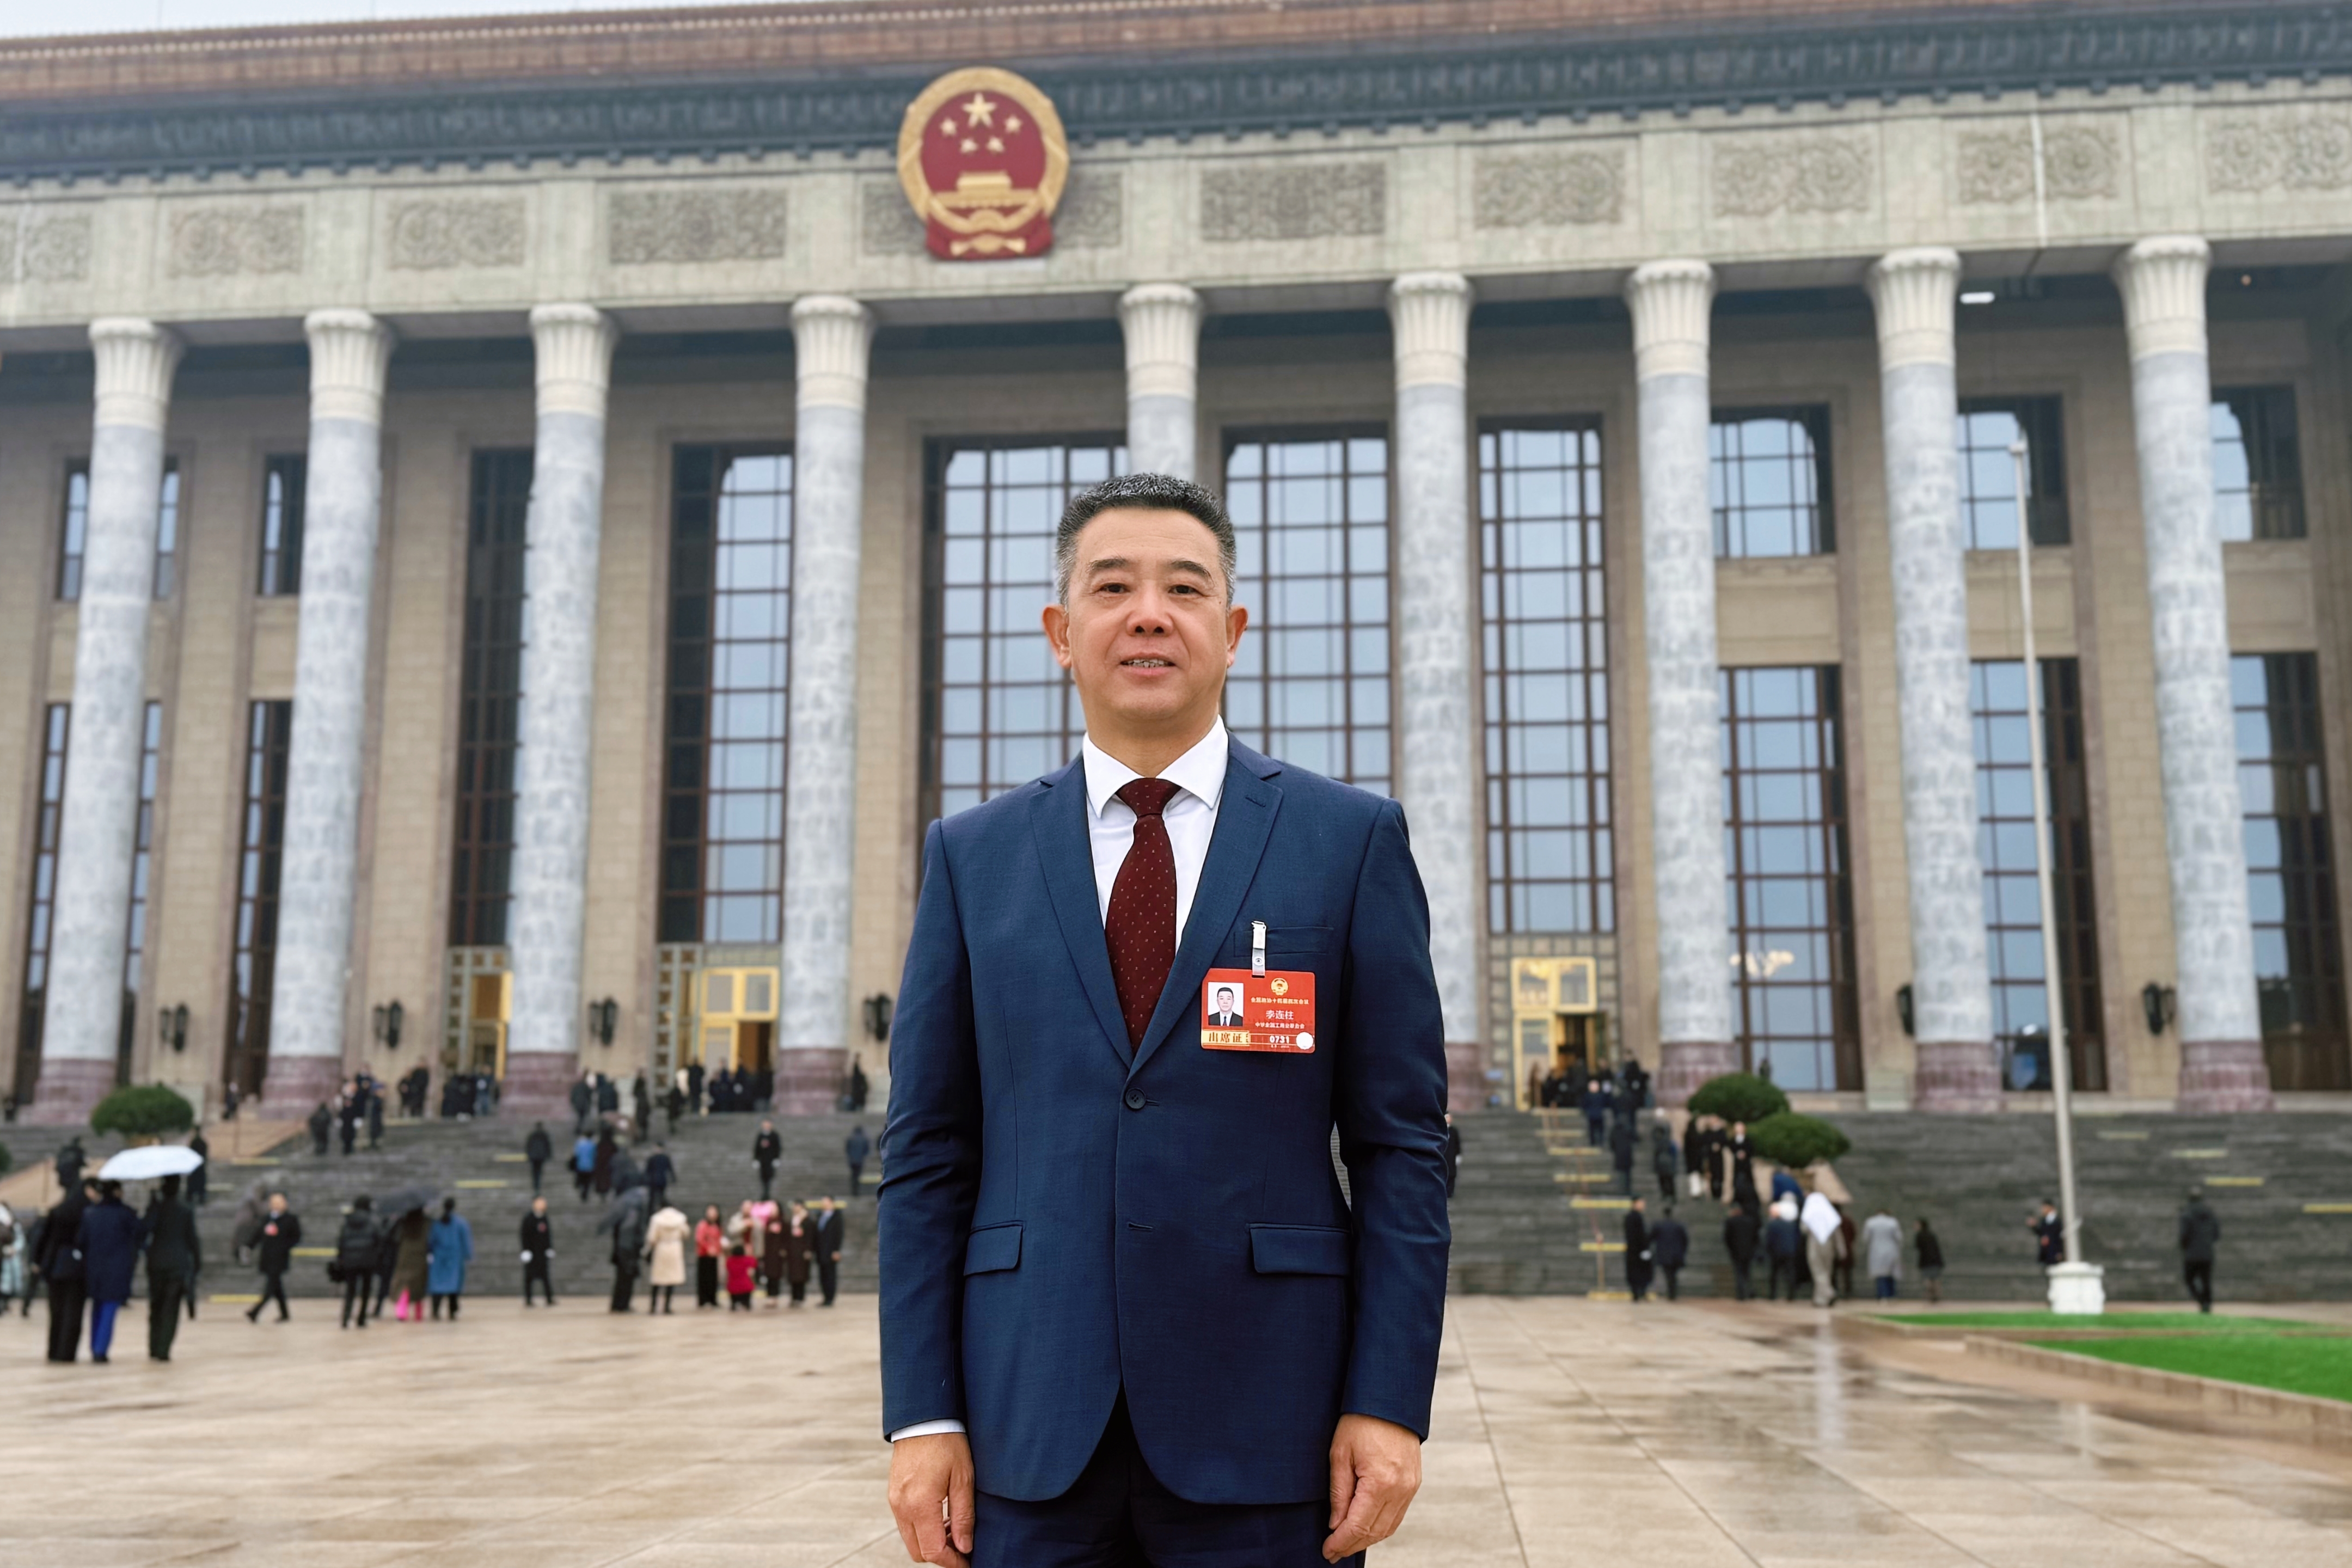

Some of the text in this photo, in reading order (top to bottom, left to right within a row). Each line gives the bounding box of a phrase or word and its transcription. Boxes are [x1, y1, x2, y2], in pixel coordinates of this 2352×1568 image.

[1266, 1009, 1294, 1020] 李连柱
[1270, 1035, 1289, 1044] 0731
